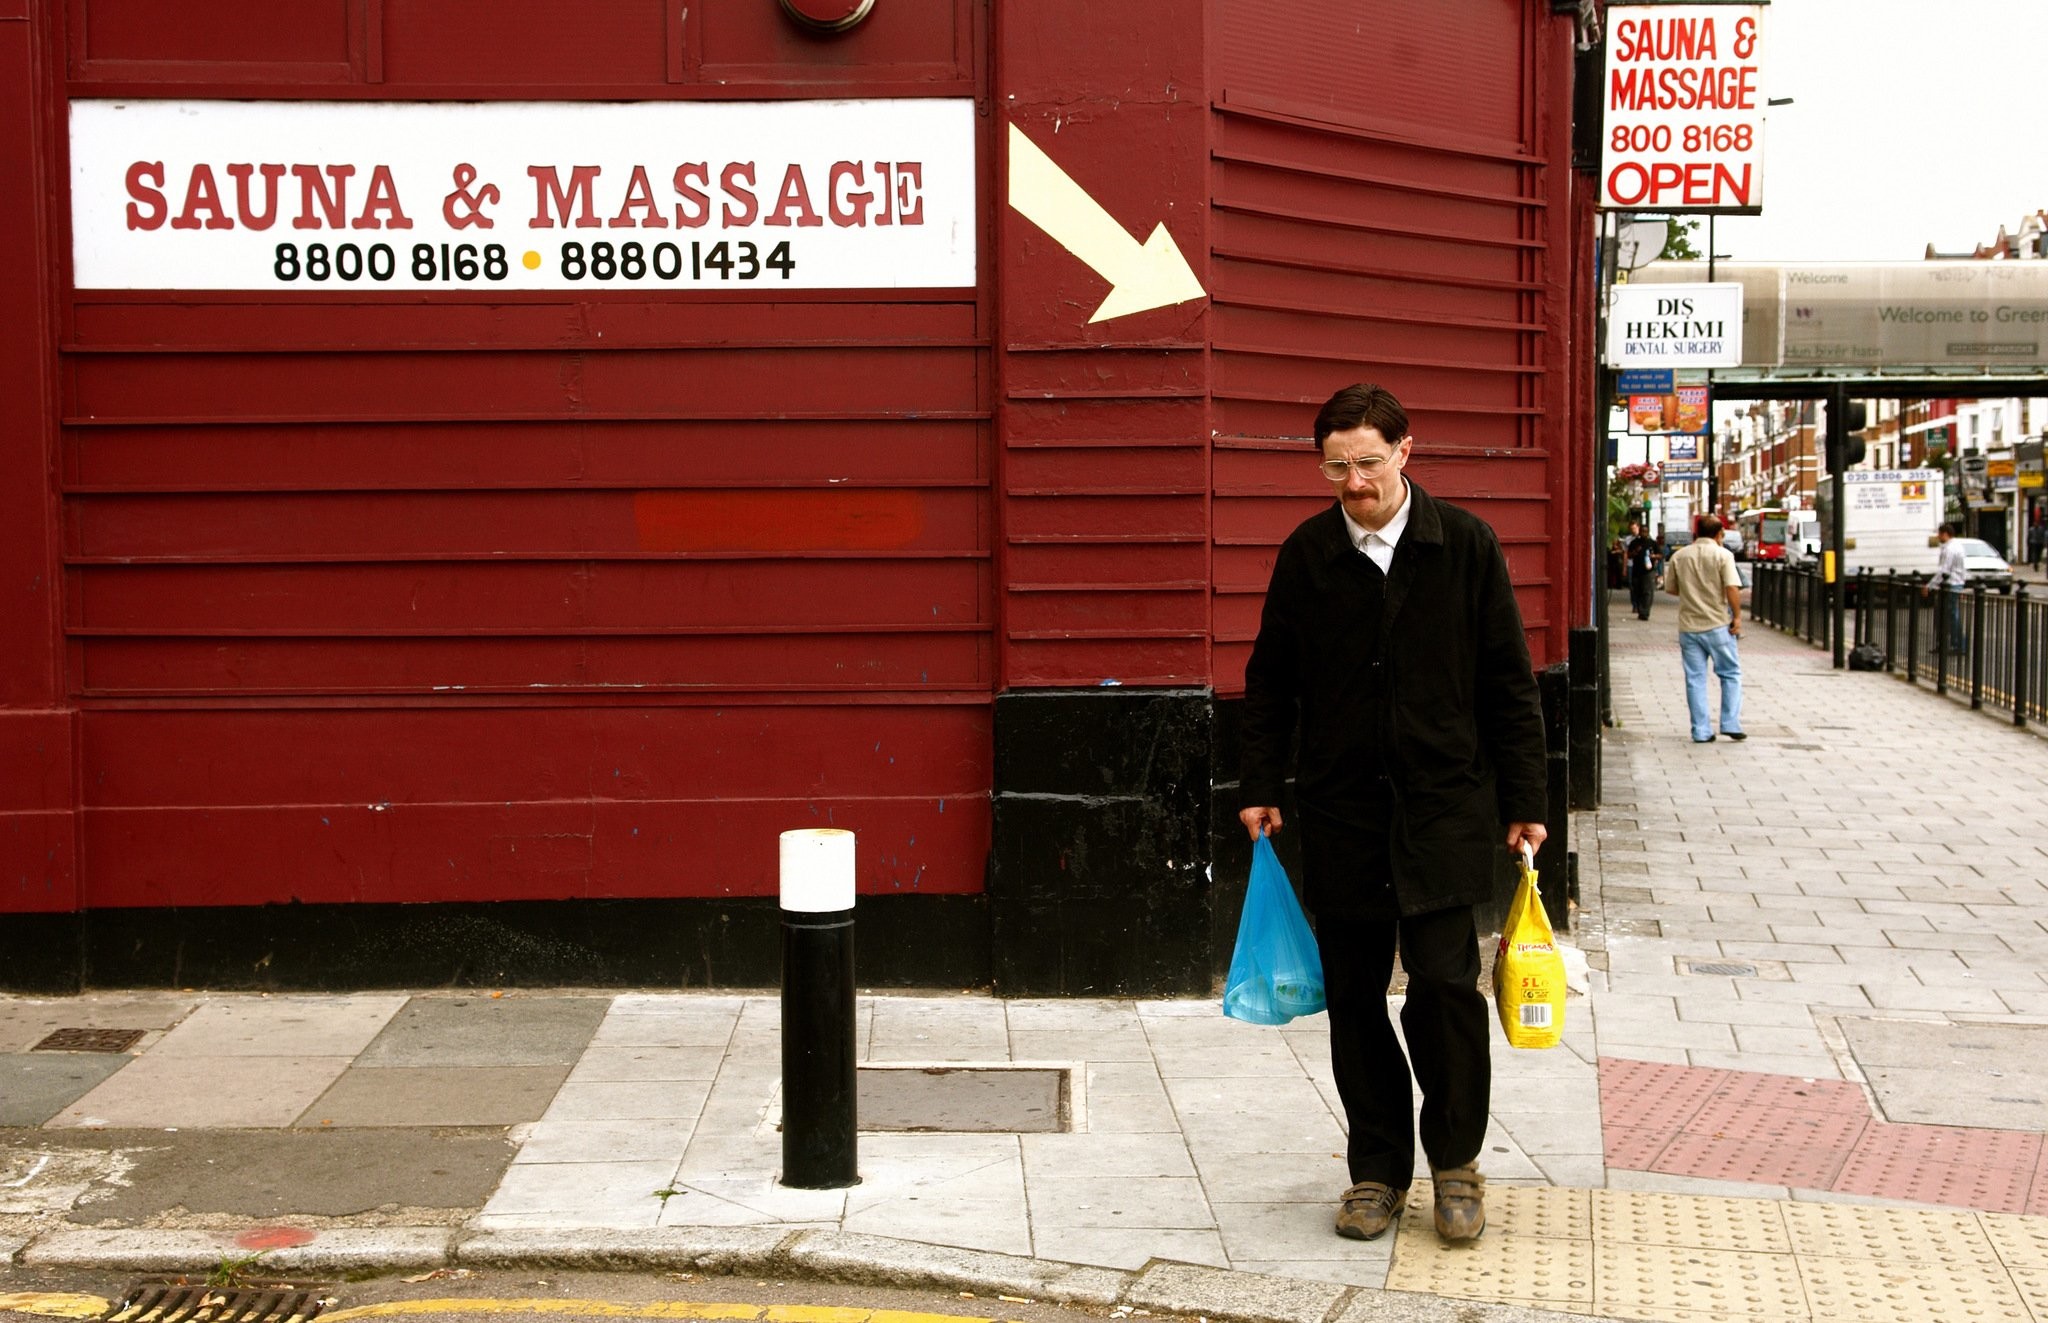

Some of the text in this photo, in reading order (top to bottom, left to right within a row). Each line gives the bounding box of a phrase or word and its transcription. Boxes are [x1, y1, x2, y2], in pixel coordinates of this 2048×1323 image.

[1616, 16, 1757, 62] SAUNA &
[1611, 67, 1757, 111] MASSAGE
[1611, 124, 1752, 153] 800 8168
[125, 159, 923, 231] SAUNA & MASSAGE
[1607, 162, 1751, 206] OPEN
[275, 242, 396, 282] 8800
[411, 242, 509, 281] 8168
[1788, 271, 1848, 284] Welcome
[1878, 306, 1963, 324] Welcome
[1970, 308, 1988, 323] to
[1625, 341, 1724, 355] DENTAL SURGERY
[1847, 473, 1868, 481] 020
[1522, 978, 1539, 987] 5 L
